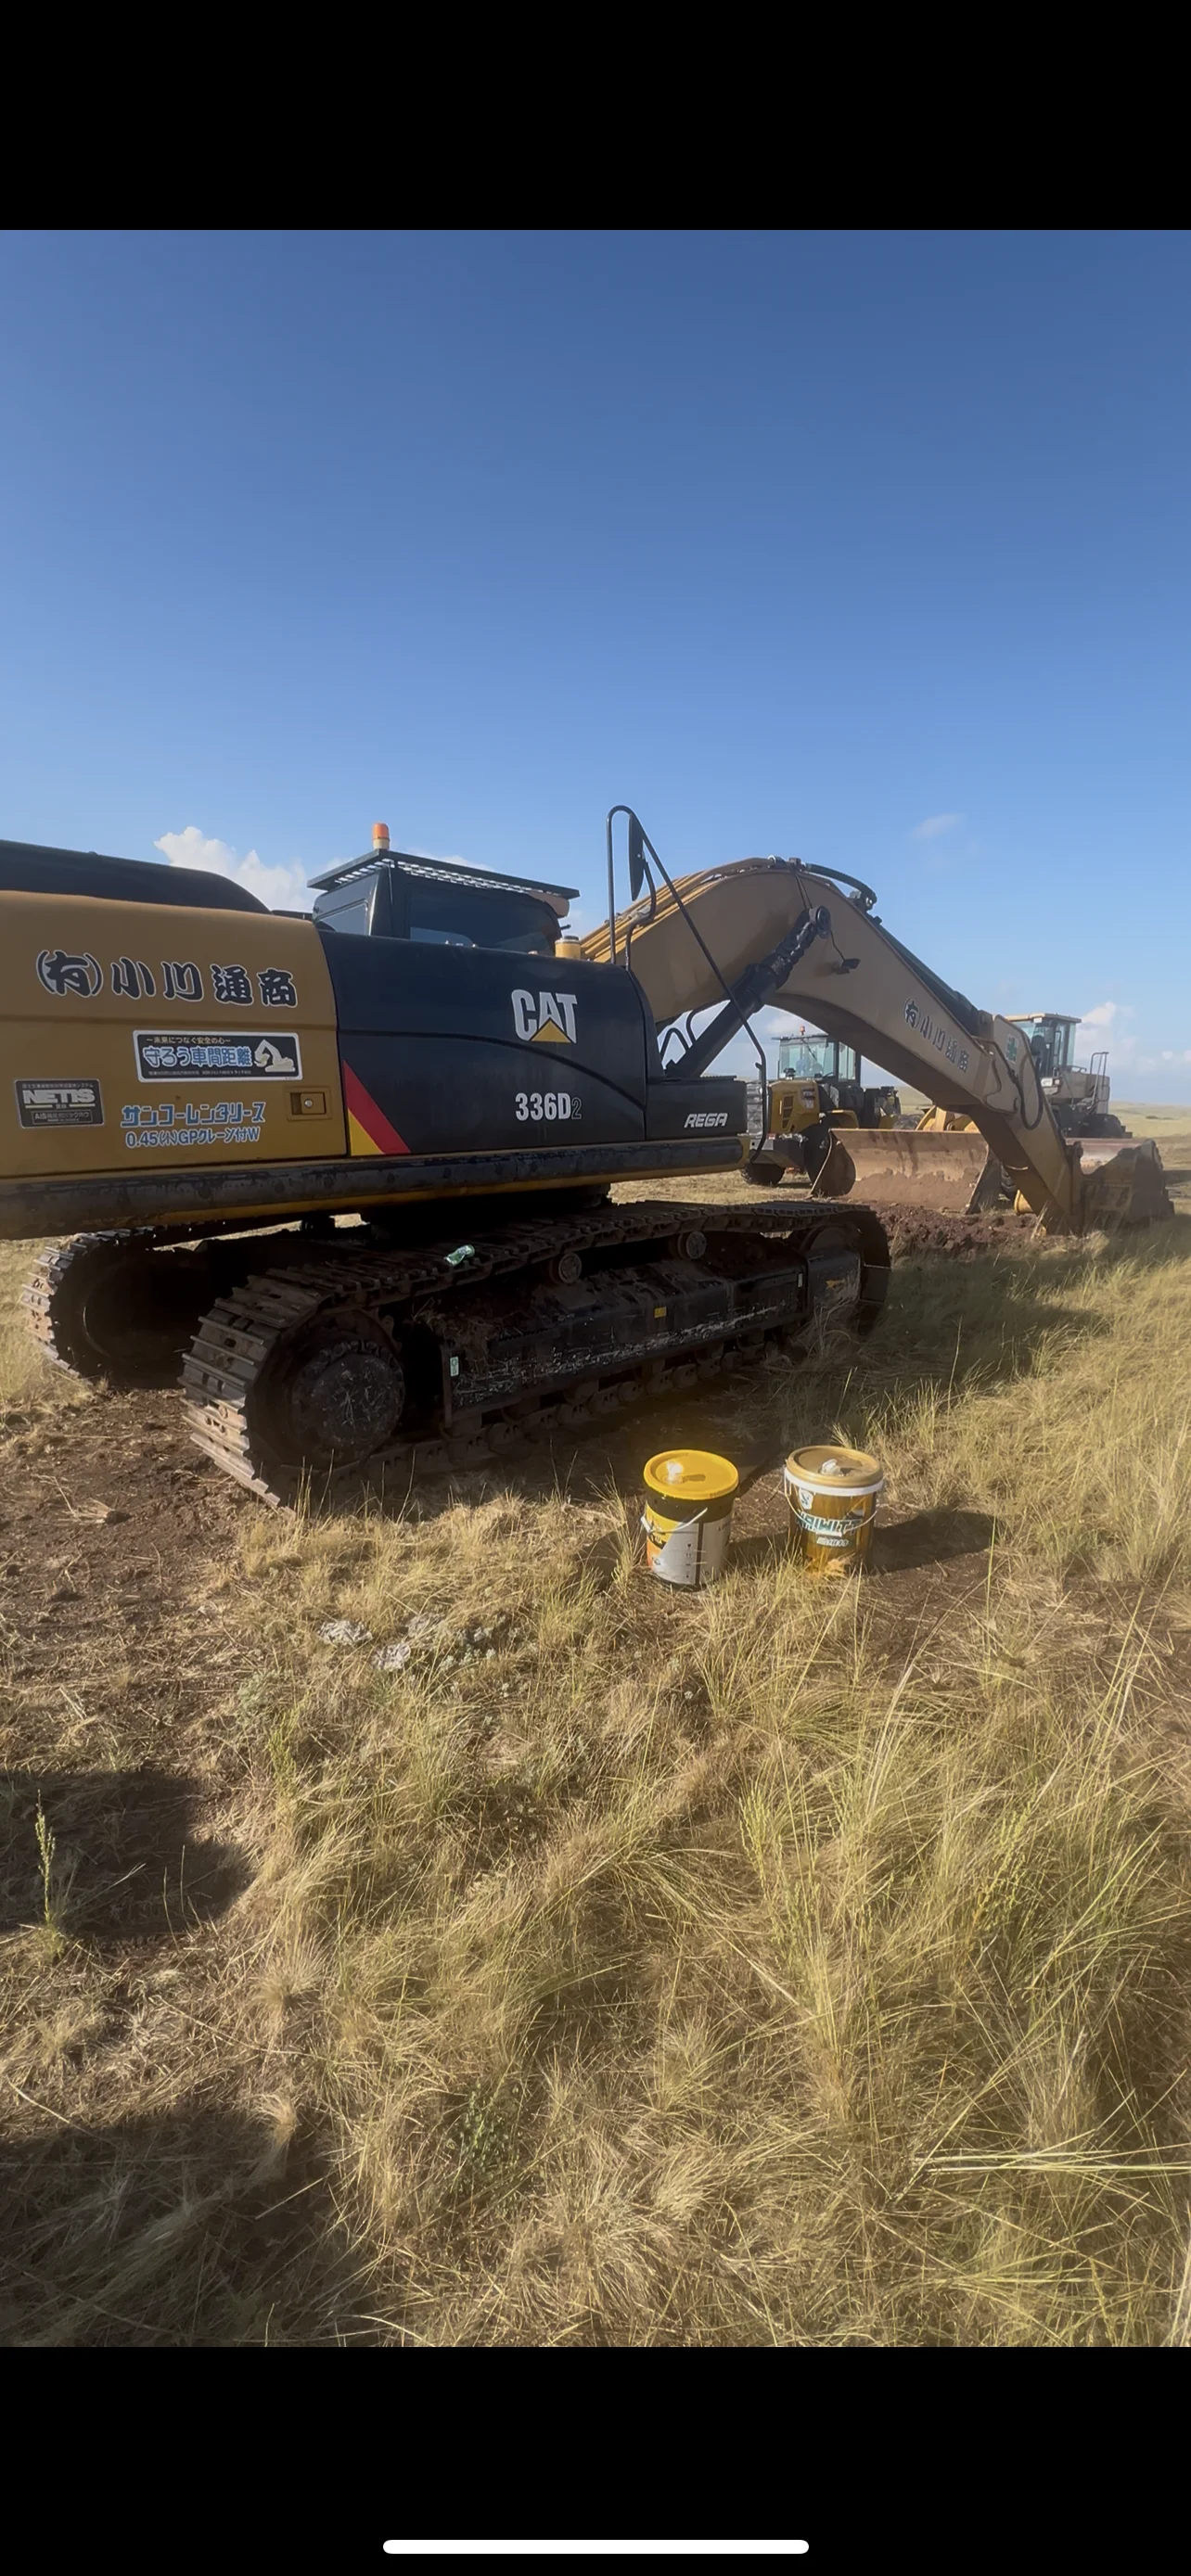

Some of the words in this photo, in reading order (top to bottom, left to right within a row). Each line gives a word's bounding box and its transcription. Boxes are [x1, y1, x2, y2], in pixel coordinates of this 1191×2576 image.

[511, 988, 579, 1044] CAT
[143, 1046, 252, 1067] 守ろう車間距離
[22, 1089, 96, 1104] NETIS
[515, 1092, 583, 1121] 336D2
[121, 1101, 266, 1129] サンコーレンタリース
